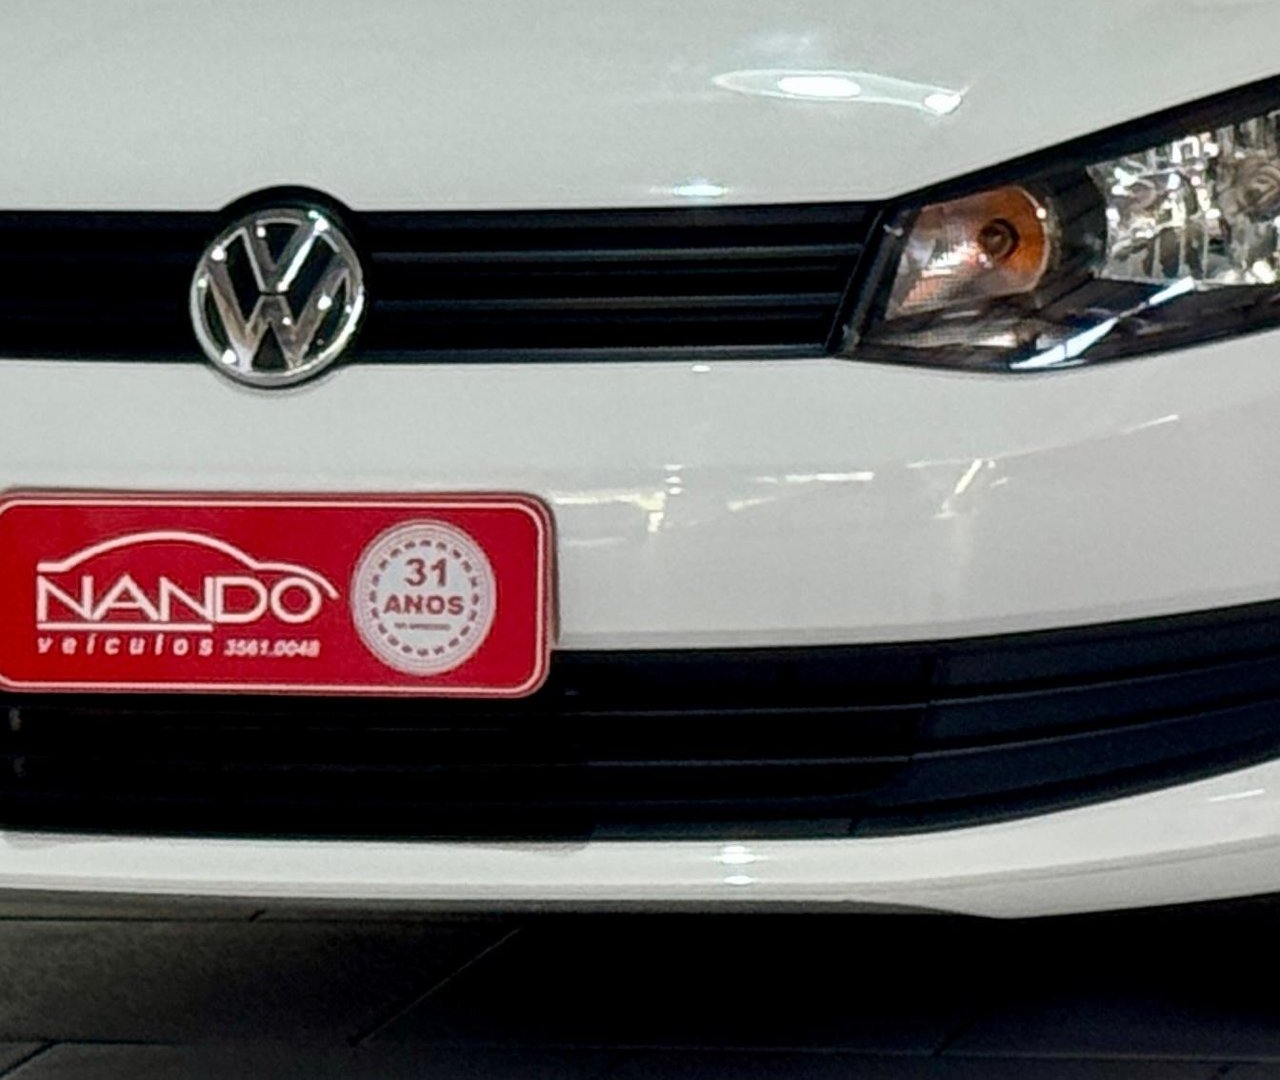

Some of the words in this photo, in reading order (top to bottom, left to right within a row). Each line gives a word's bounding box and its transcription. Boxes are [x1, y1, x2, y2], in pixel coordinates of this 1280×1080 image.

[404, 557, 448, 588] 31
[36, 574, 322, 624] NANDO
[382, 594, 465, 616] ANOS
